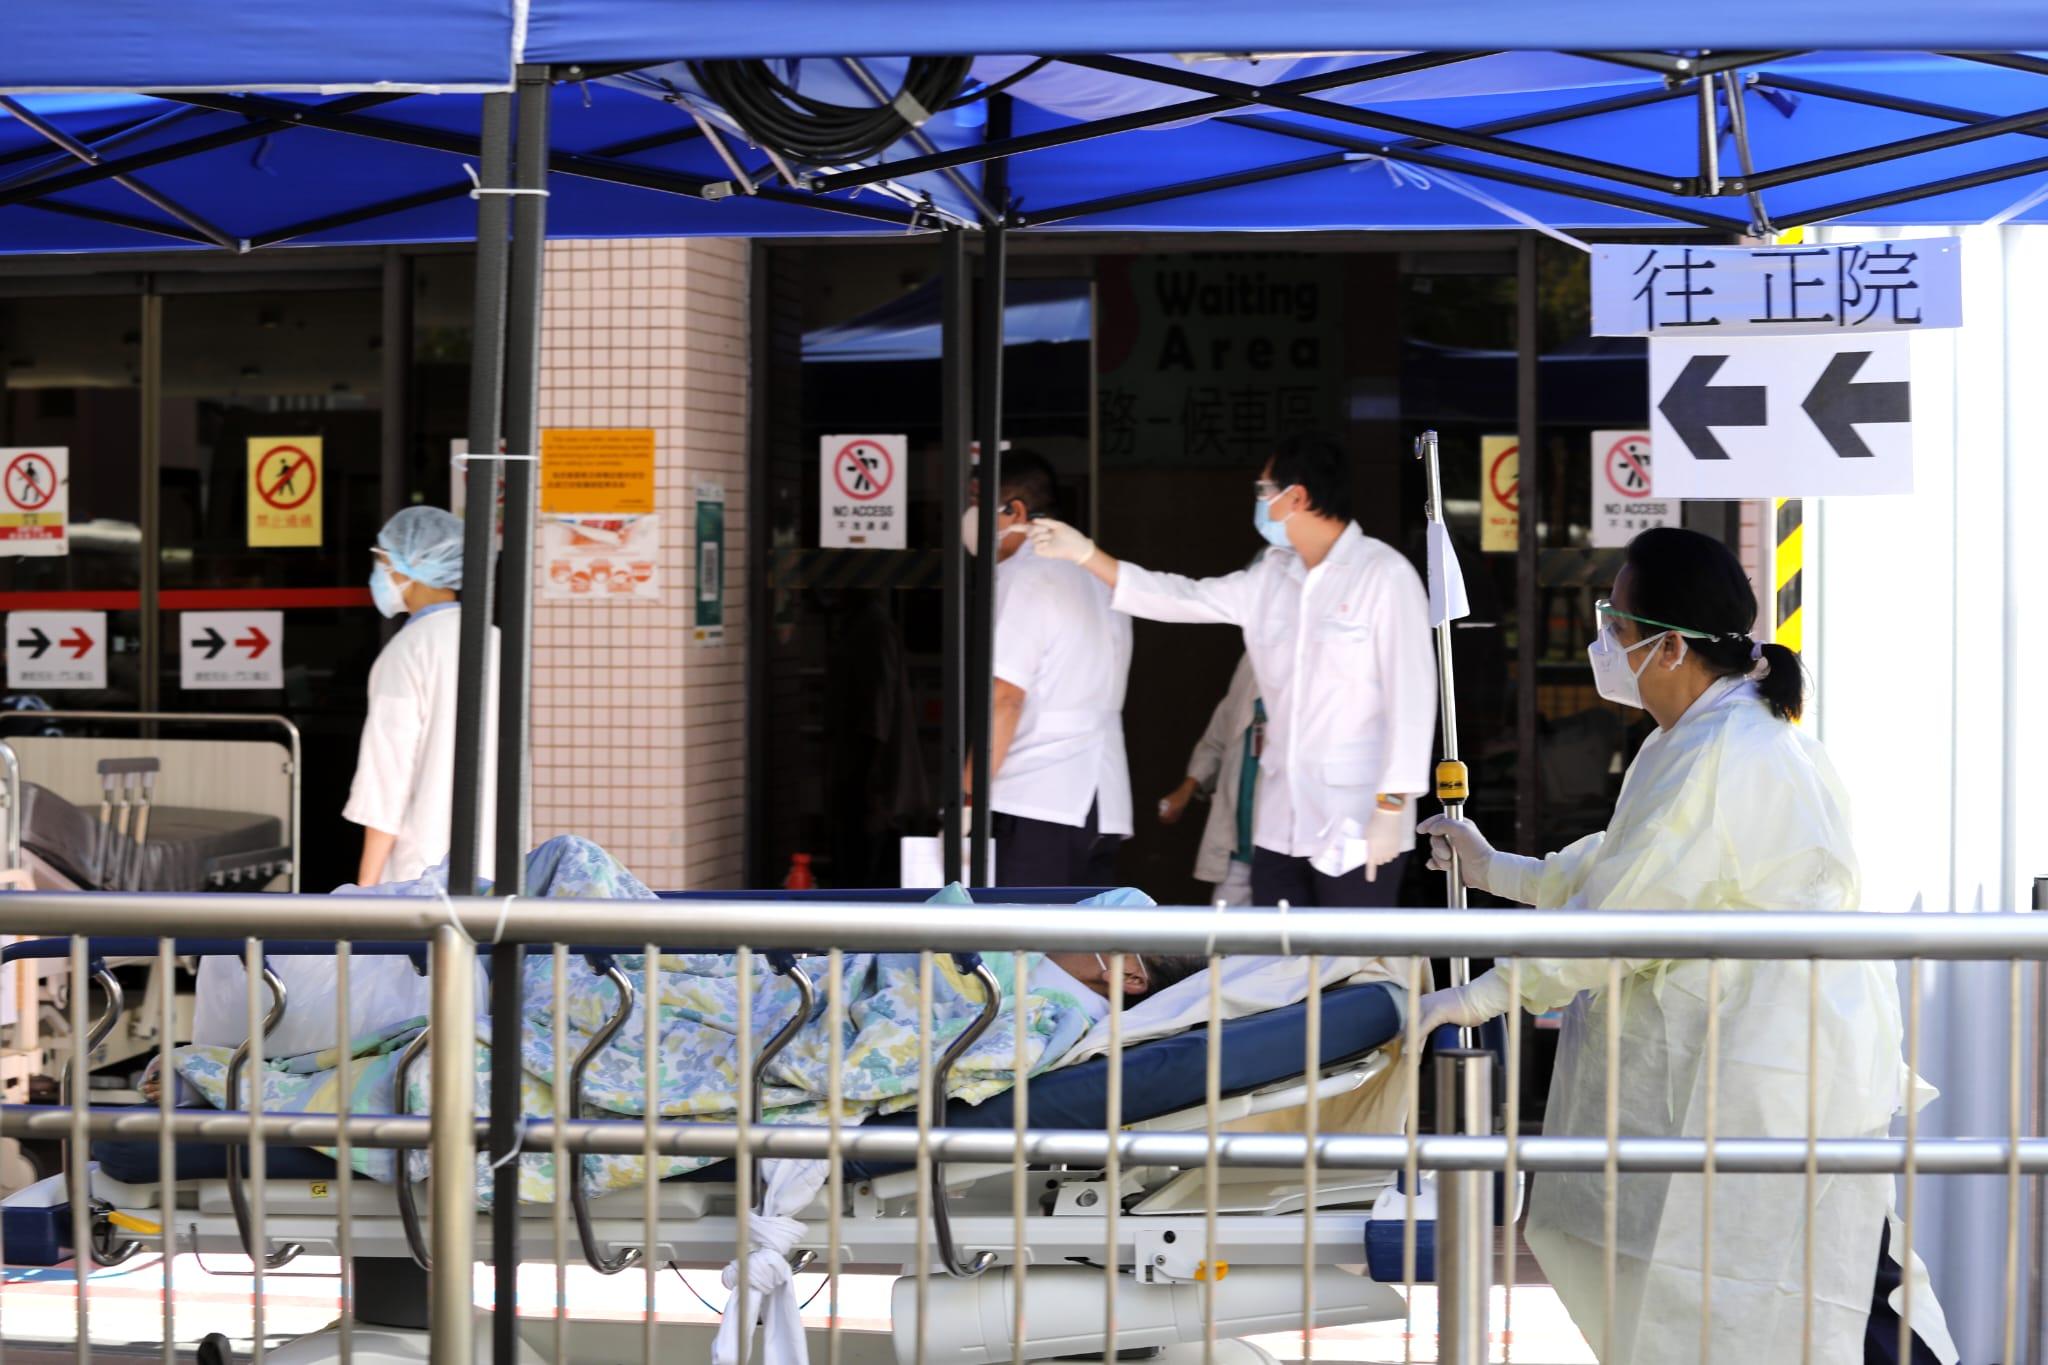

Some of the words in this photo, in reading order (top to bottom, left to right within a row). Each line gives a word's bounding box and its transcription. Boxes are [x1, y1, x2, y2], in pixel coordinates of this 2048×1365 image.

[1155, 271, 1319, 323] Waiting
[1156, 325, 1320, 371] Area
[833, 505, 849, 517] NO
[851, 505, 894, 517] ACCESS
[1604, 504, 1620, 515] NO
[1623, 504, 1668, 515] ACCESS
